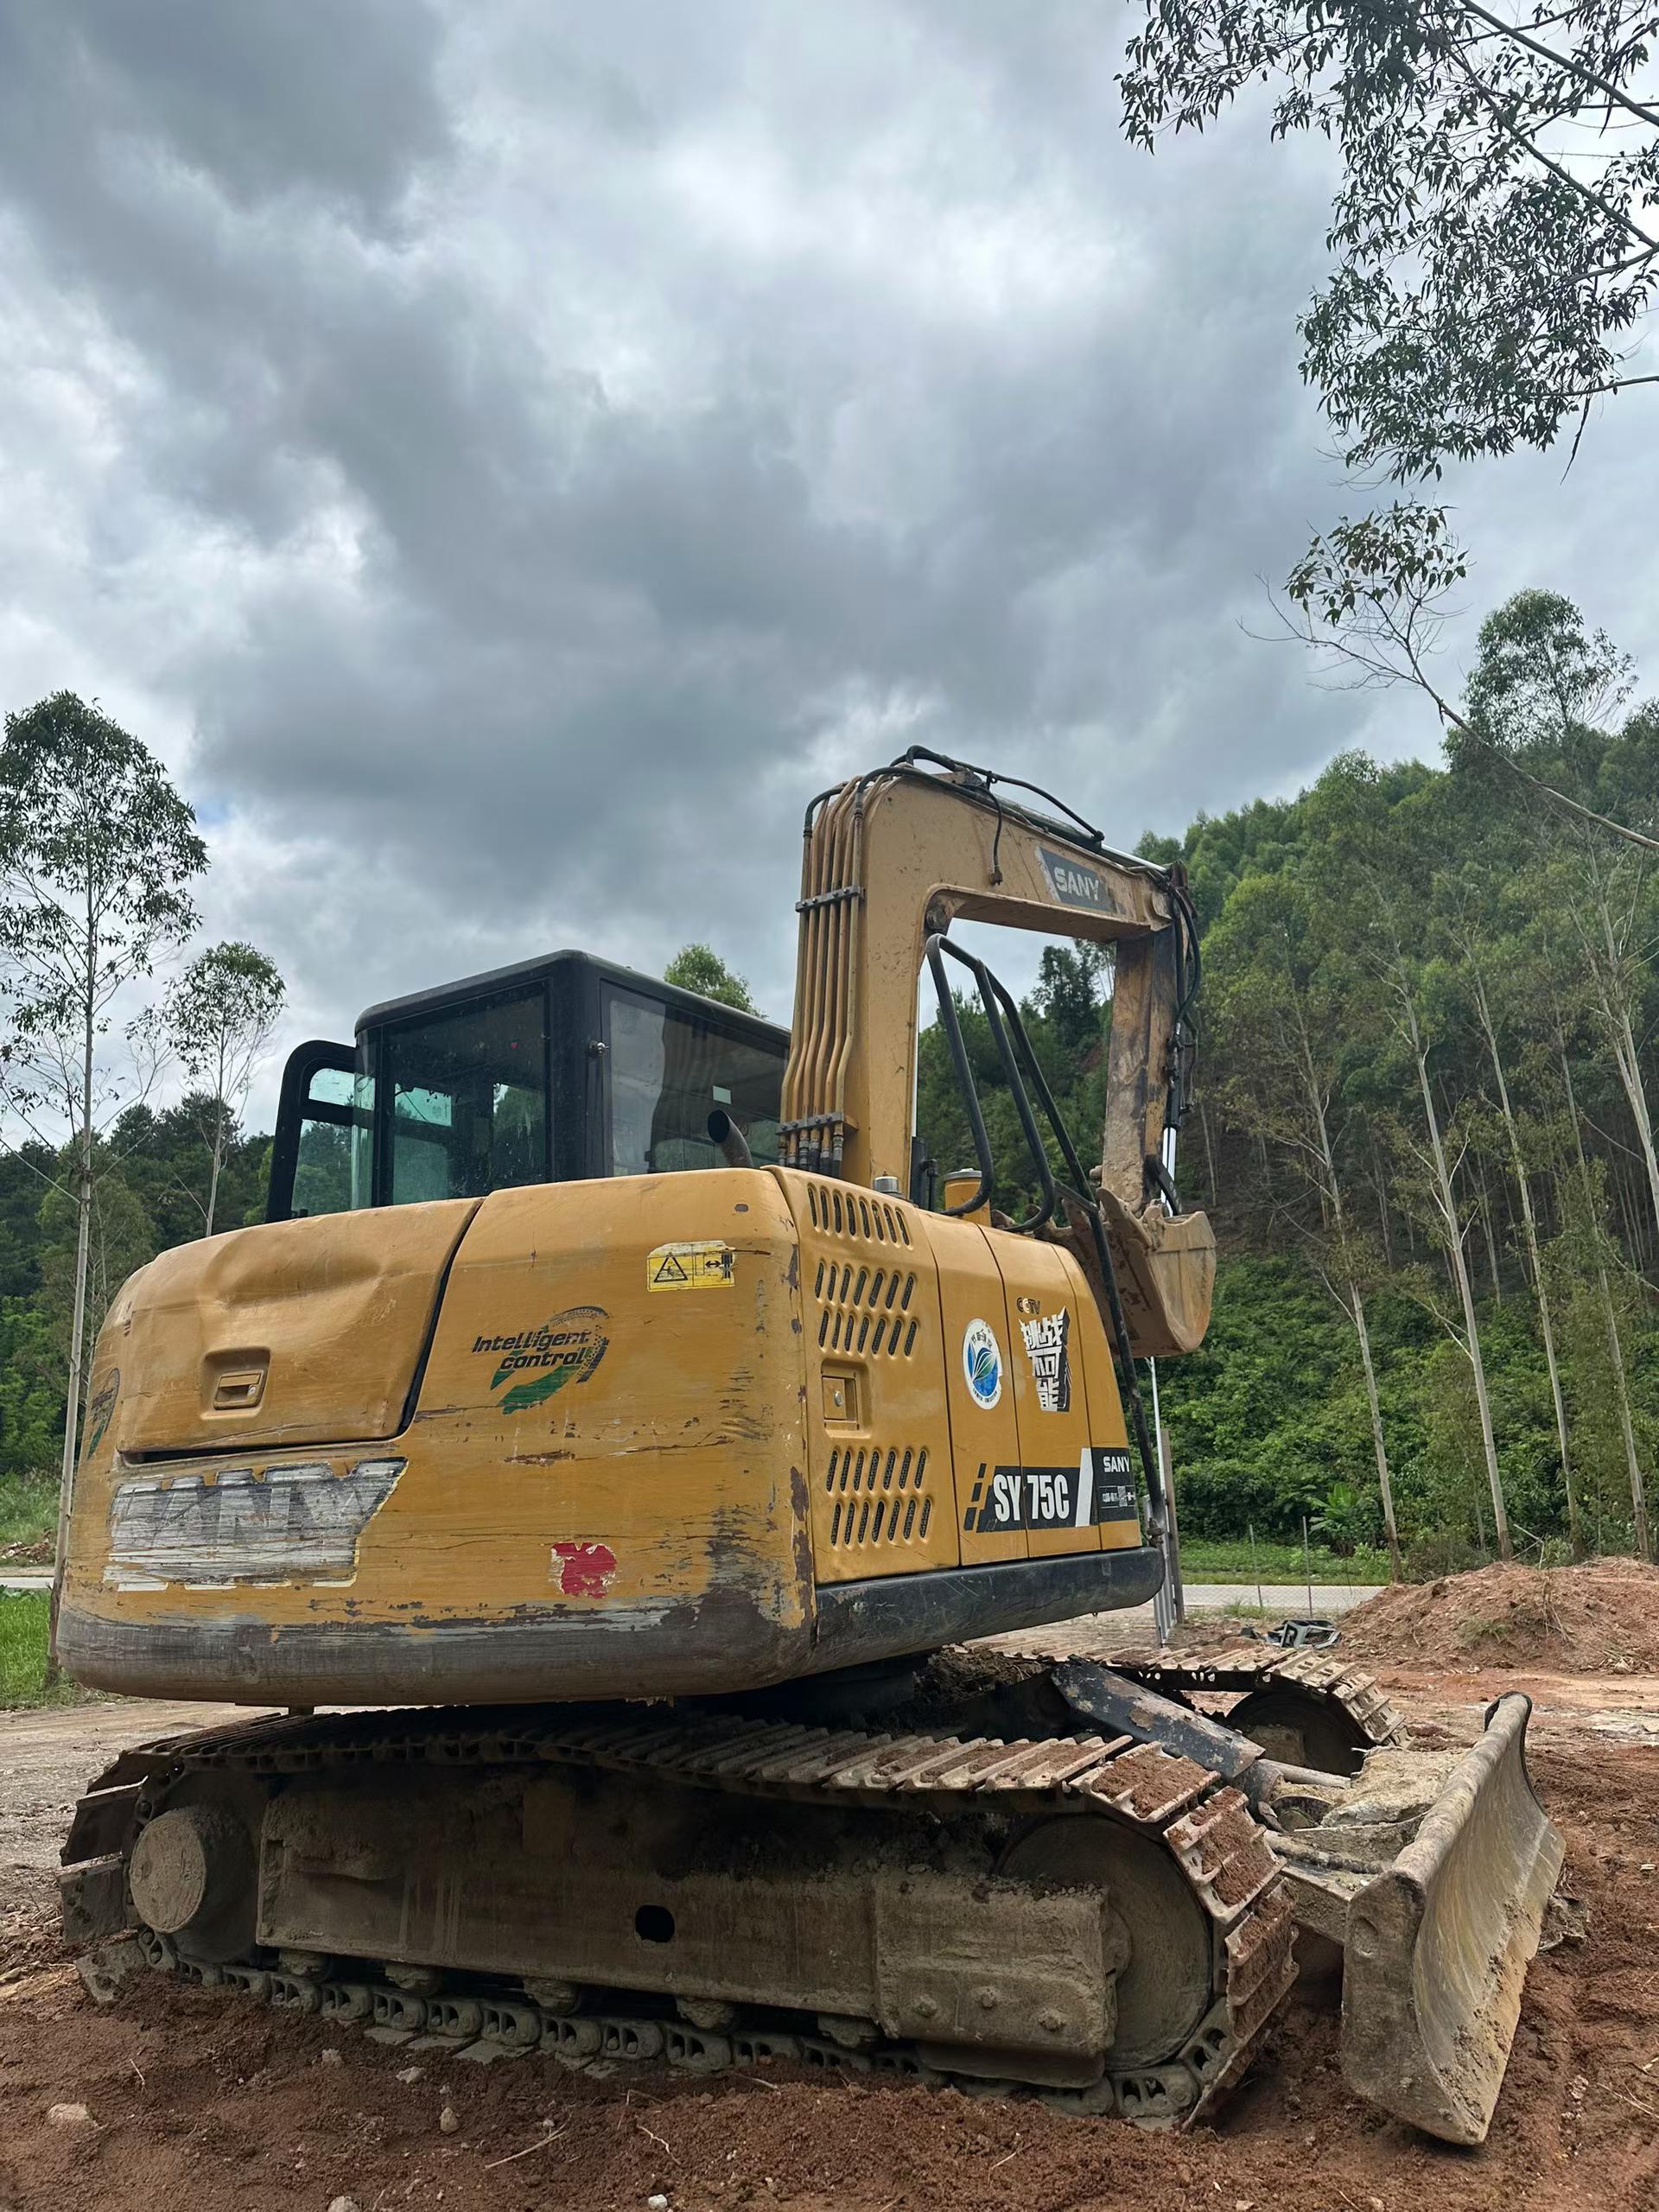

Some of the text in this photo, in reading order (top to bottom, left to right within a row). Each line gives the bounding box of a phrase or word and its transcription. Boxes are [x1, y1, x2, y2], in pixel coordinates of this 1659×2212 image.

[1054, 867, 1099, 900] SANY
[472, 1329, 592, 1353] Intelligent
[499, 1346, 588, 1370] control
[1103, 1456, 1130, 1473] SANY
